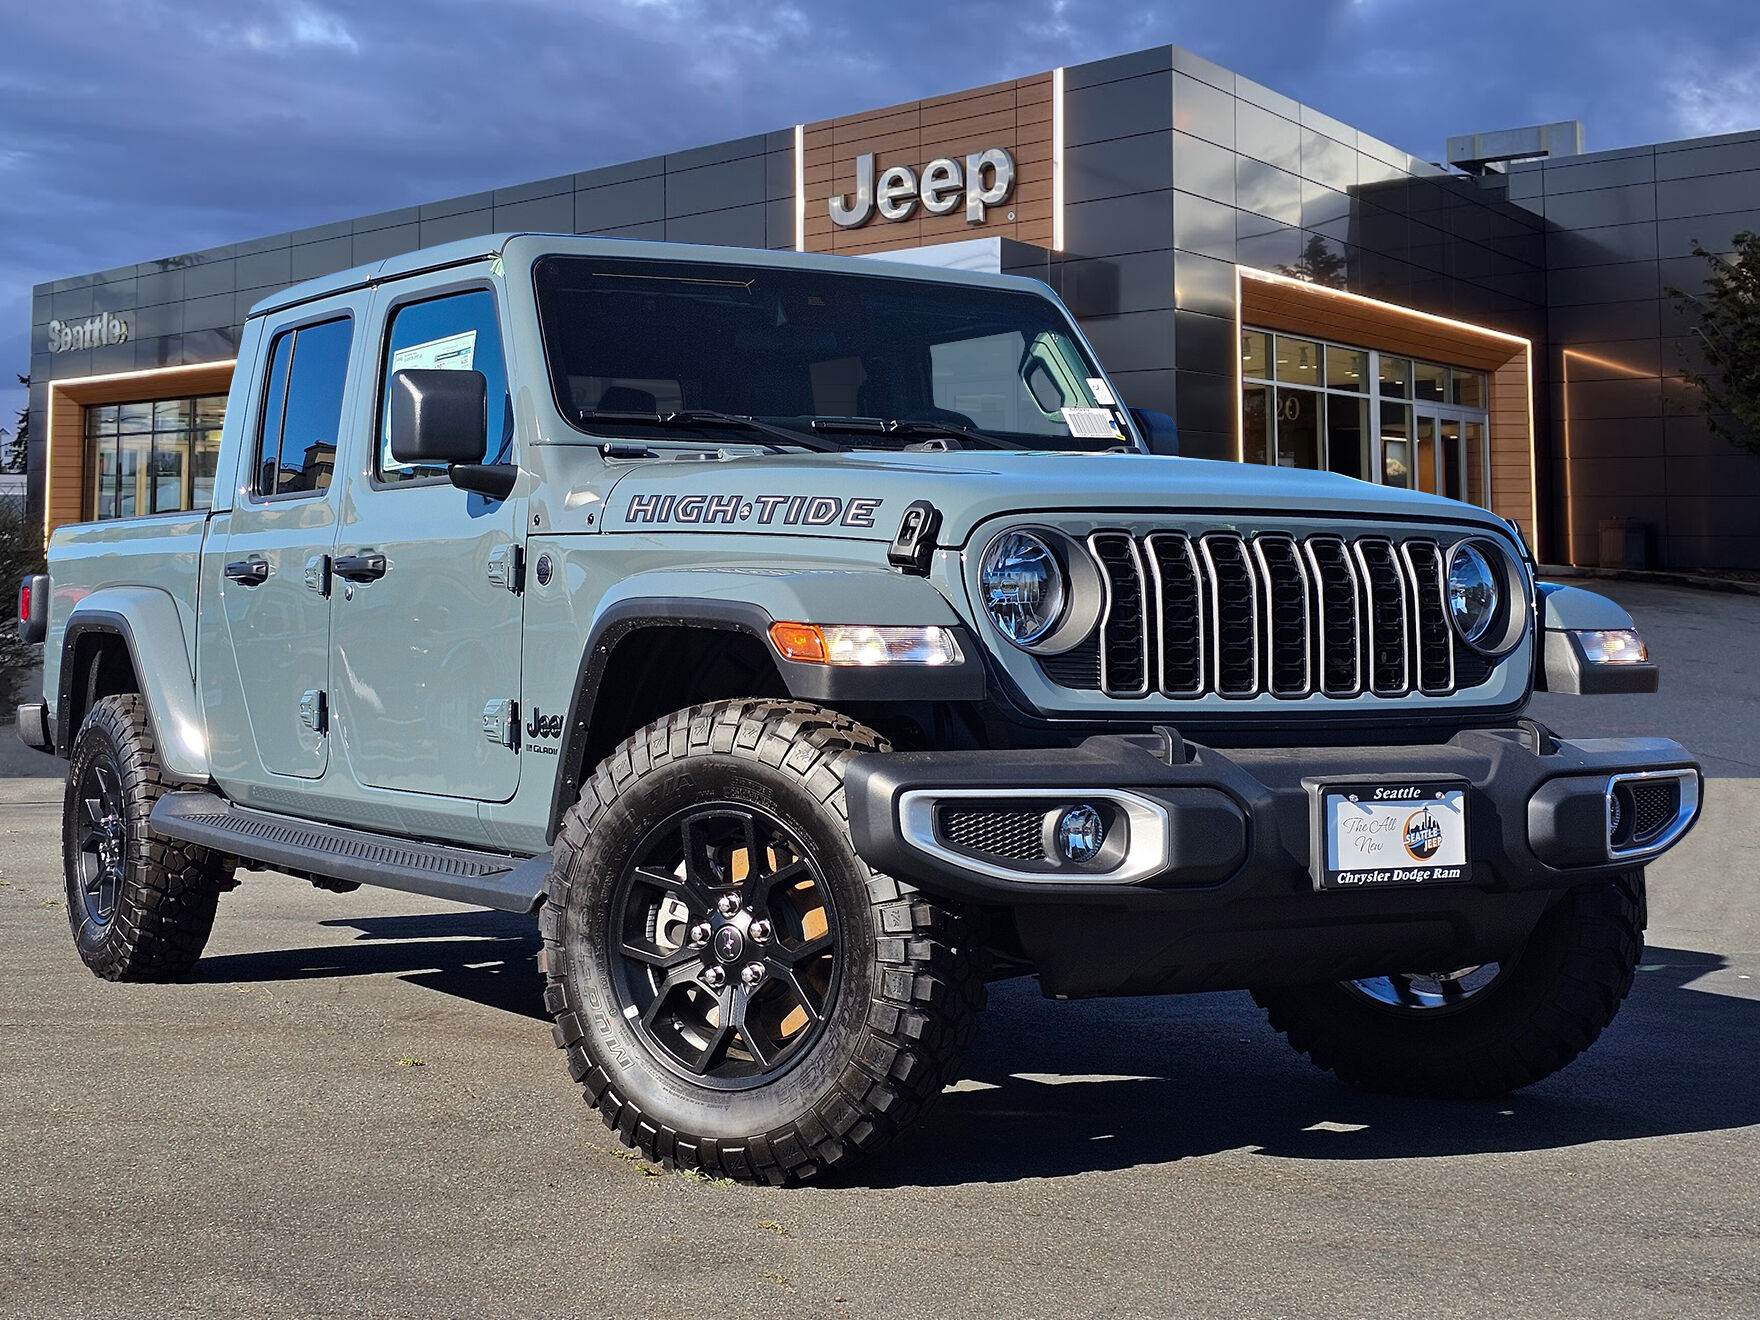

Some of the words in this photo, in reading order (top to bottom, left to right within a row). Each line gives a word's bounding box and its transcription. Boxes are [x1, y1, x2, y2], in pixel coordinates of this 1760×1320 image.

[828, 147, 1016, 228] Jeep
[48, 312, 127, 354] Seattle
[626, 495, 744, 524] HIGH
[755, 495, 884, 528] TIDE
[1373, 787, 1421, 800] Seattle
[1369, 816, 1397, 834] All
[1354, 835, 1384, 854] New
[1405, 827, 1439, 844] SEATTLE
[1337, 872, 1391, 885] Chrysler
[1391, 869, 1431, 882] Dodge
[1432, 868, 1461, 880] Ram
